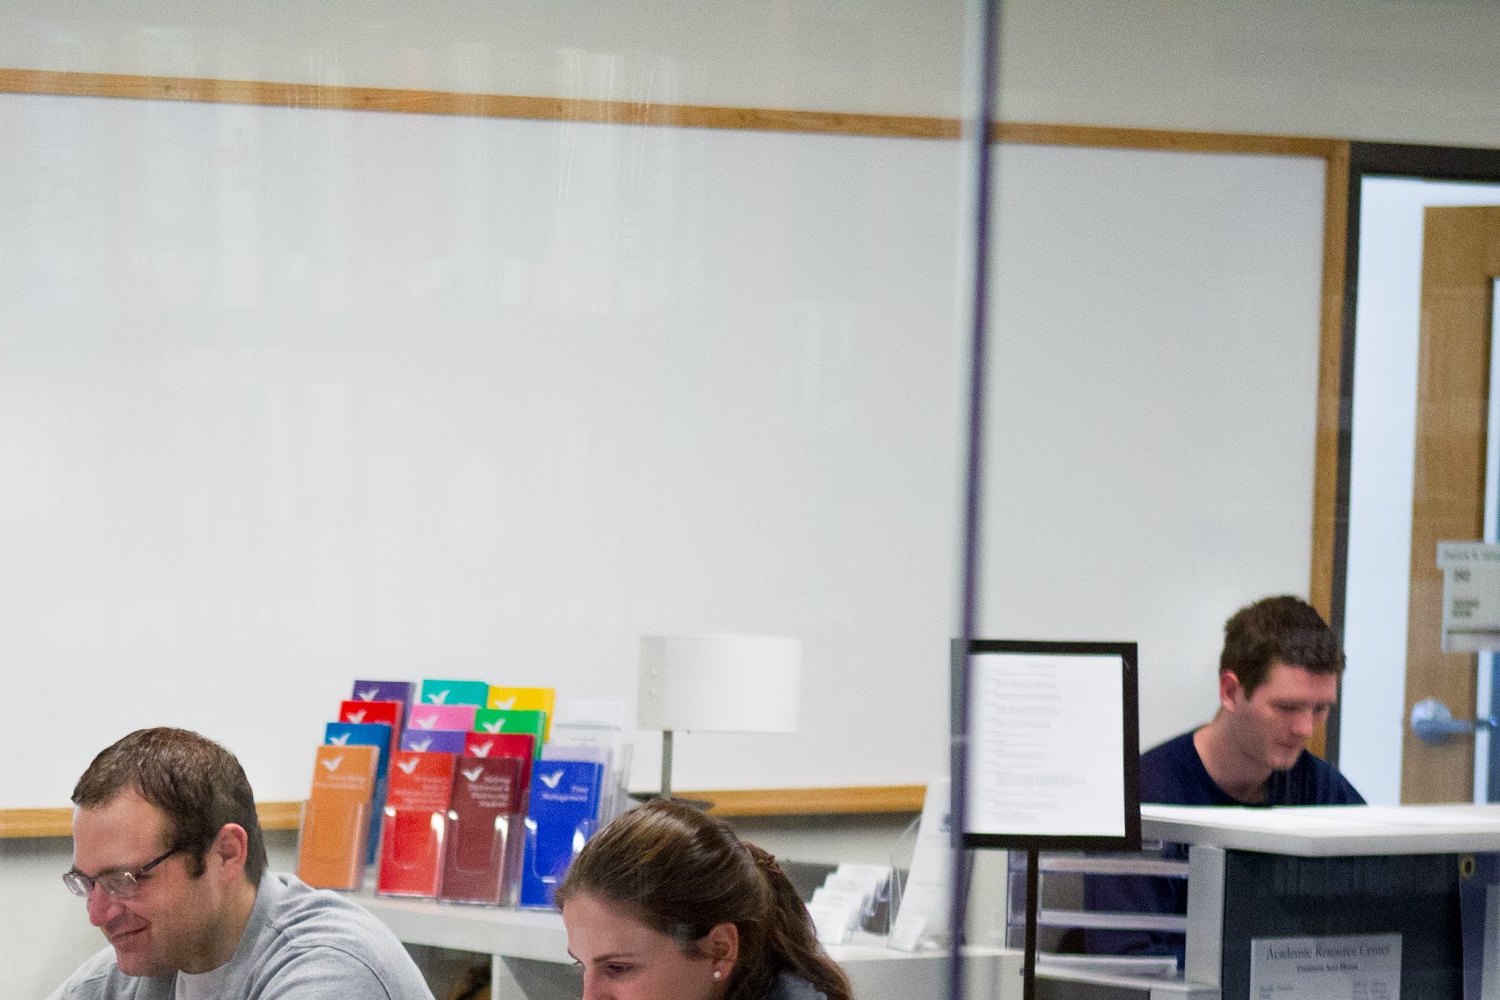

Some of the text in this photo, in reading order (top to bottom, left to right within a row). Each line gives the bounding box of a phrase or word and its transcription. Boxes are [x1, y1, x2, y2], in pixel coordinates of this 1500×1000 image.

[1266, 943, 1390, 960] Academic Resource Center
